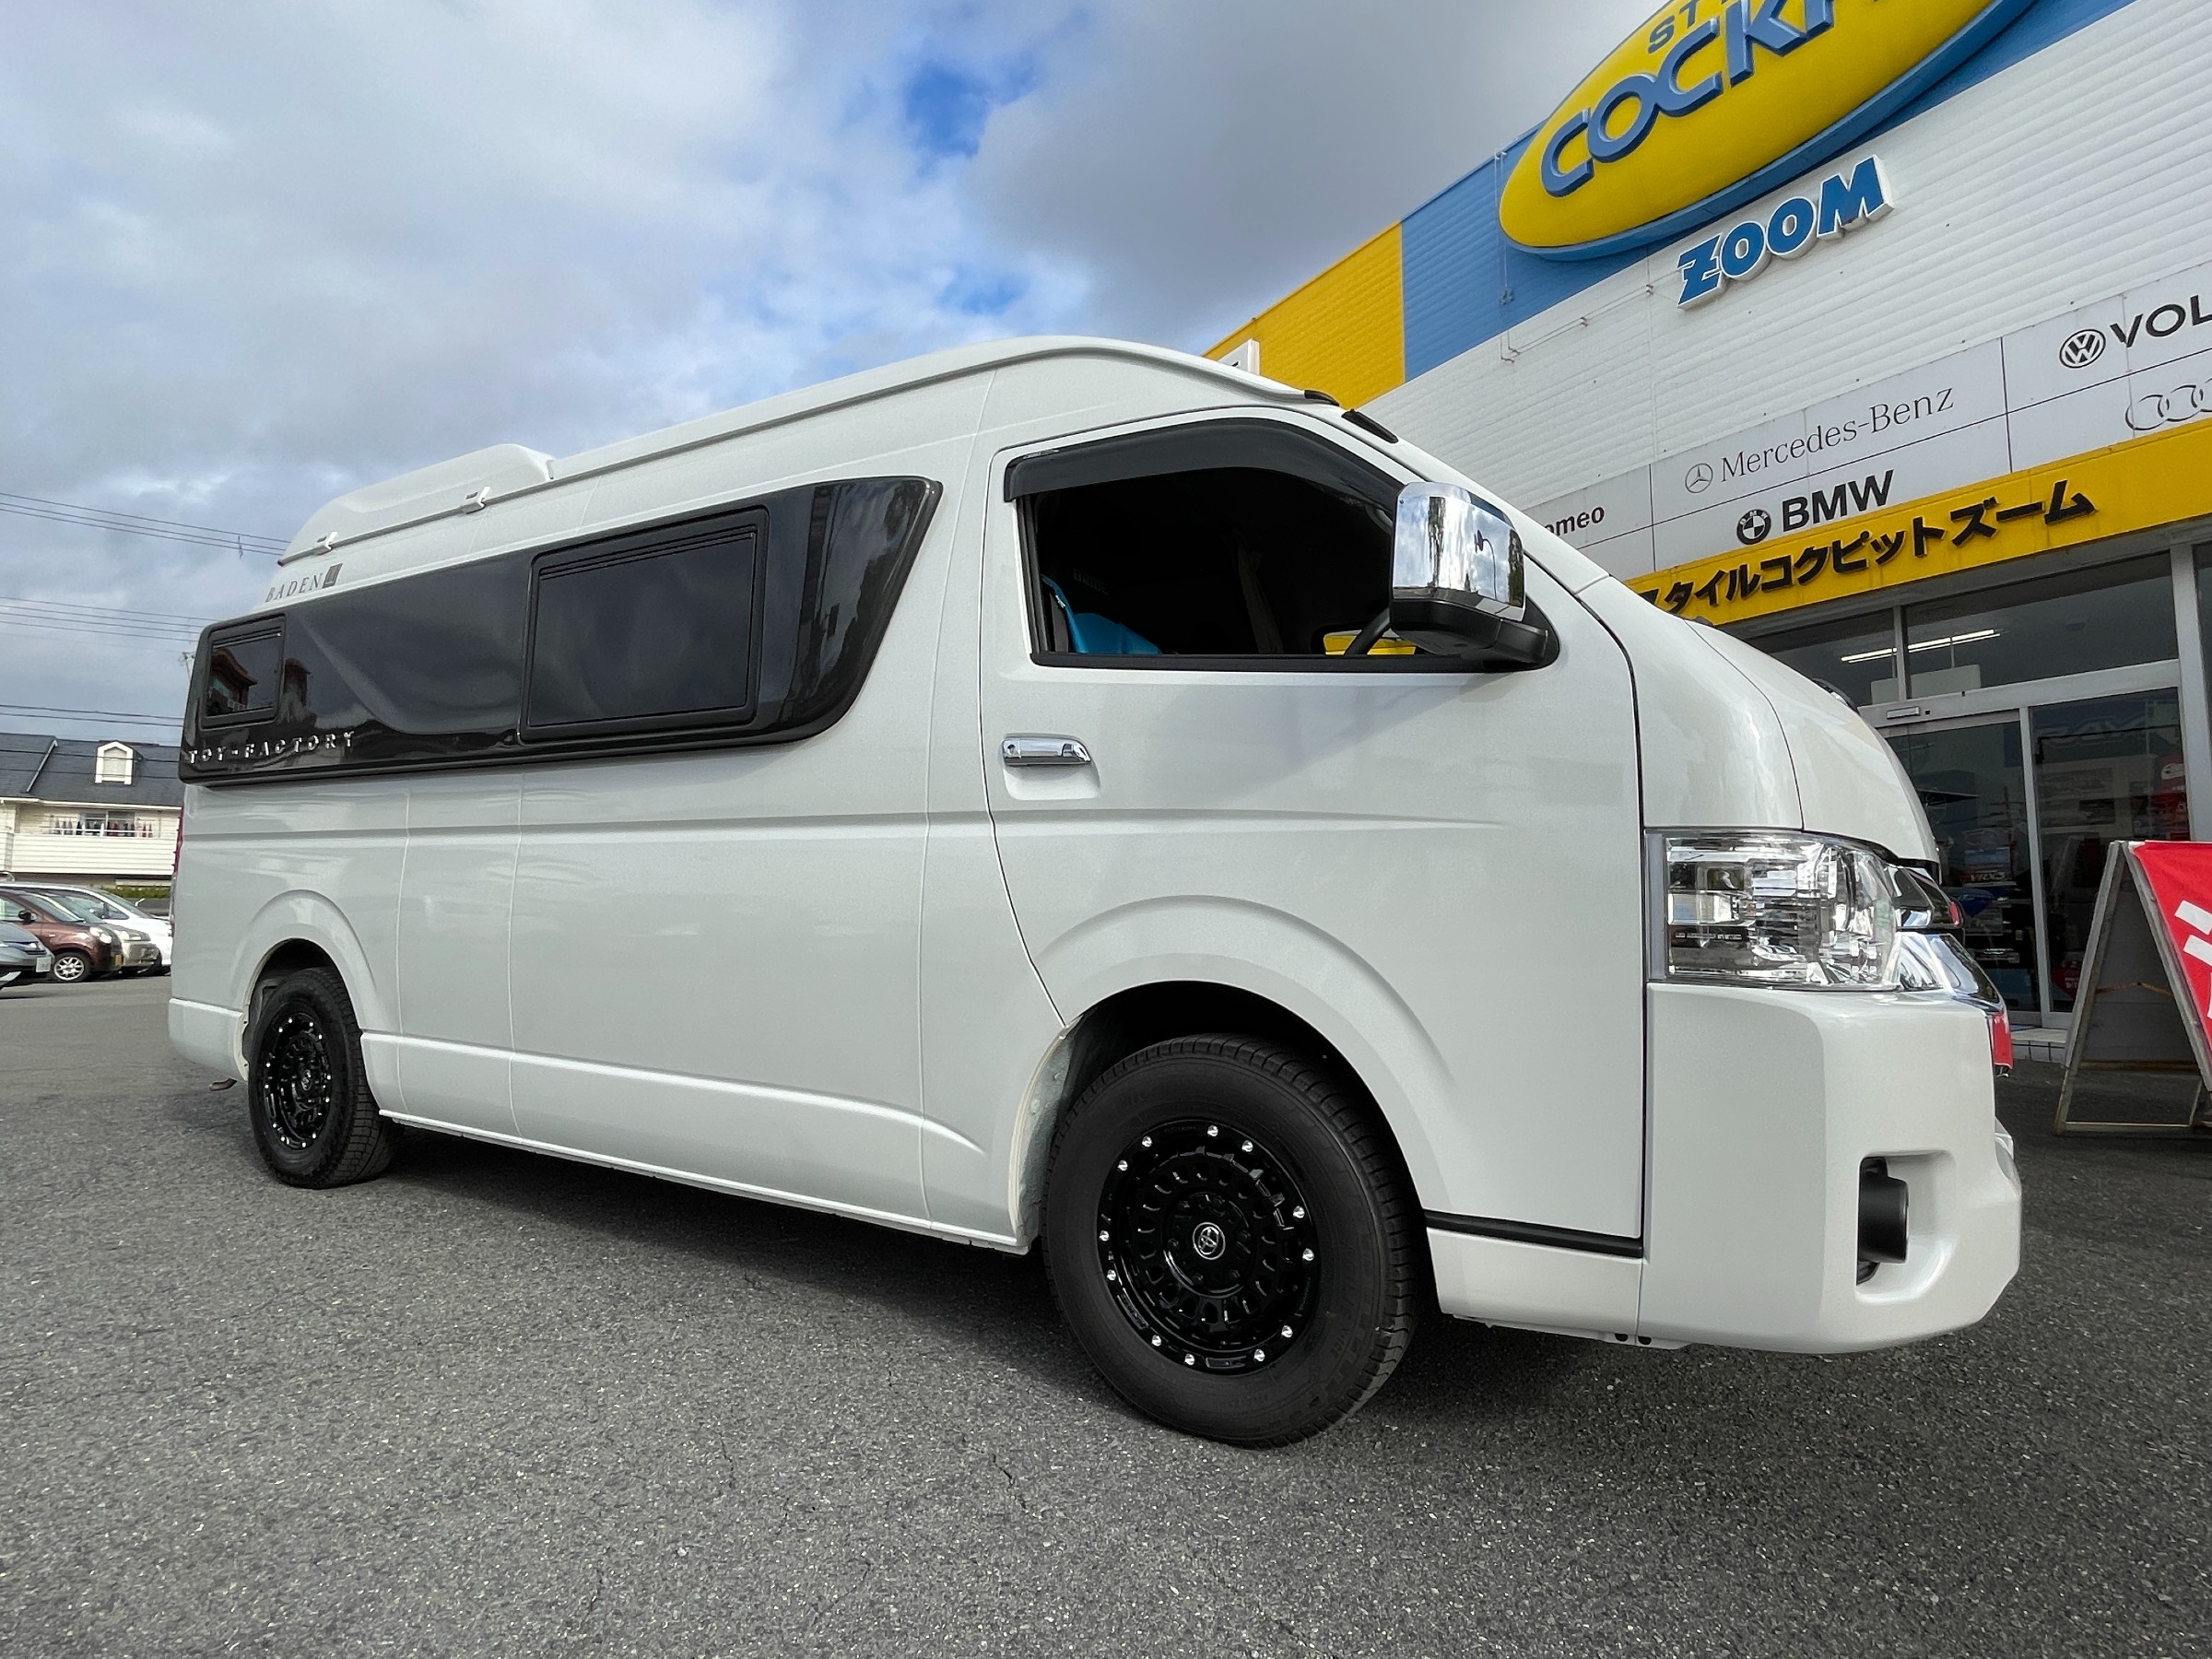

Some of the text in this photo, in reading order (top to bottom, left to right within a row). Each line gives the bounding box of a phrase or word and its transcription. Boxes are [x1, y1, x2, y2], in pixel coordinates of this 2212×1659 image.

[1648, 0, 1733, 53] ST
[1677, 155, 1892, 309] ZOOM
[1721, 388, 1954, 482] Mercedes-Benz
[1783, 470, 1894, 532] BMW
[265, 572, 324, 603] BADEN
[188, 731, 354, 764] TOY-FACTORY
